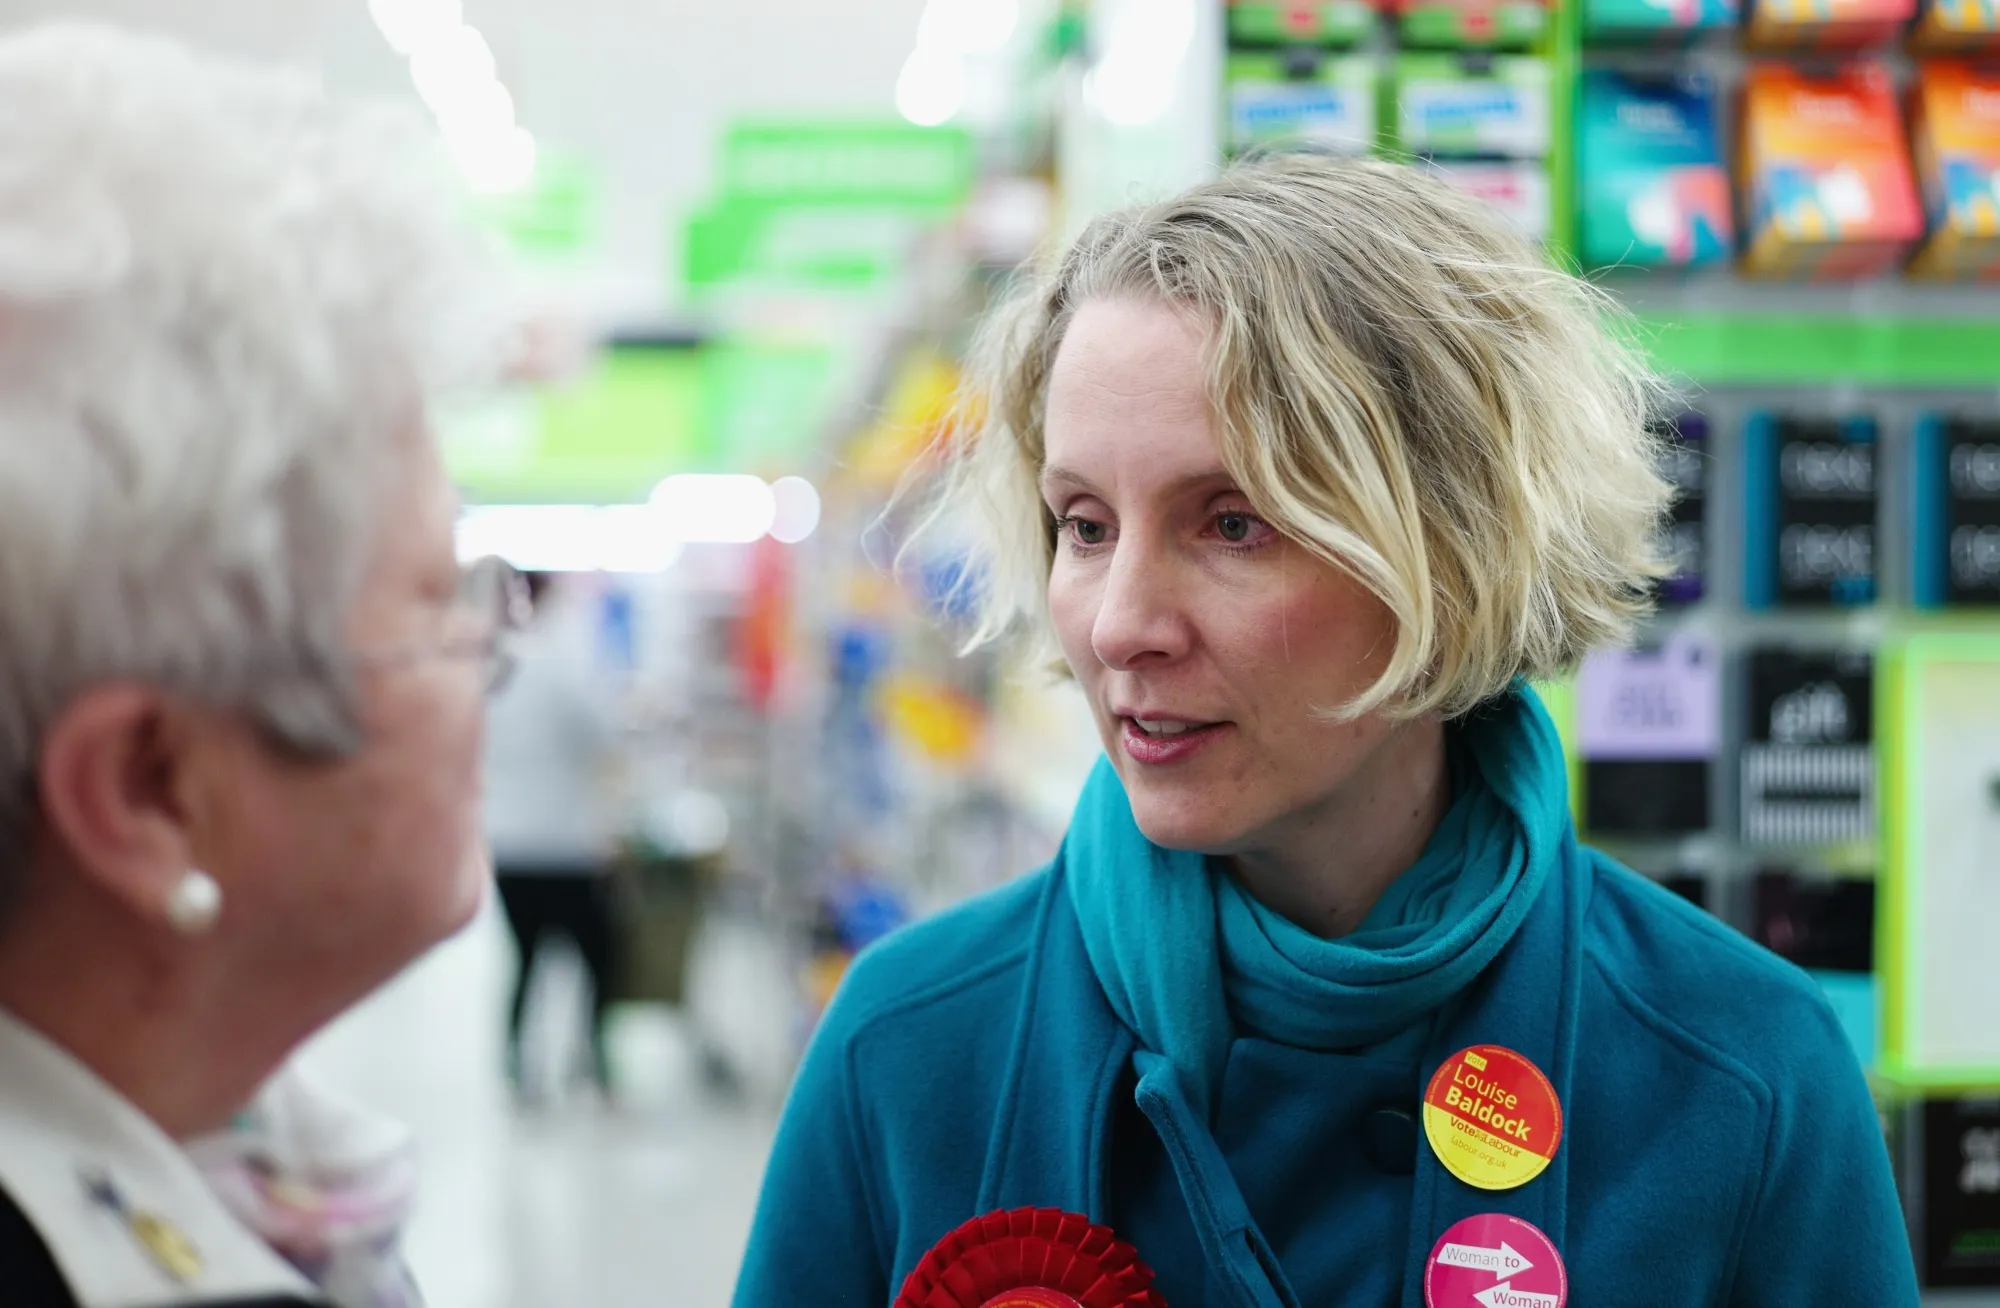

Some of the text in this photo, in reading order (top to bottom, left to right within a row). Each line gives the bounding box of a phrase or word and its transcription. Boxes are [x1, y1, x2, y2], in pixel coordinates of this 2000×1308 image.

[1453, 1063, 1518, 1110] Louise
[1445, 1085, 1531, 1141] Baldock
[1450, 1115, 1476, 1136] Vote
[1484, 1134, 1521, 1158] Labour
[1451, 1135, 1507, 1169] labour.org.uk
[1446, 1246, 1520, 1268] Woman to
[1493, 1291, 1552, 1308] Woman
